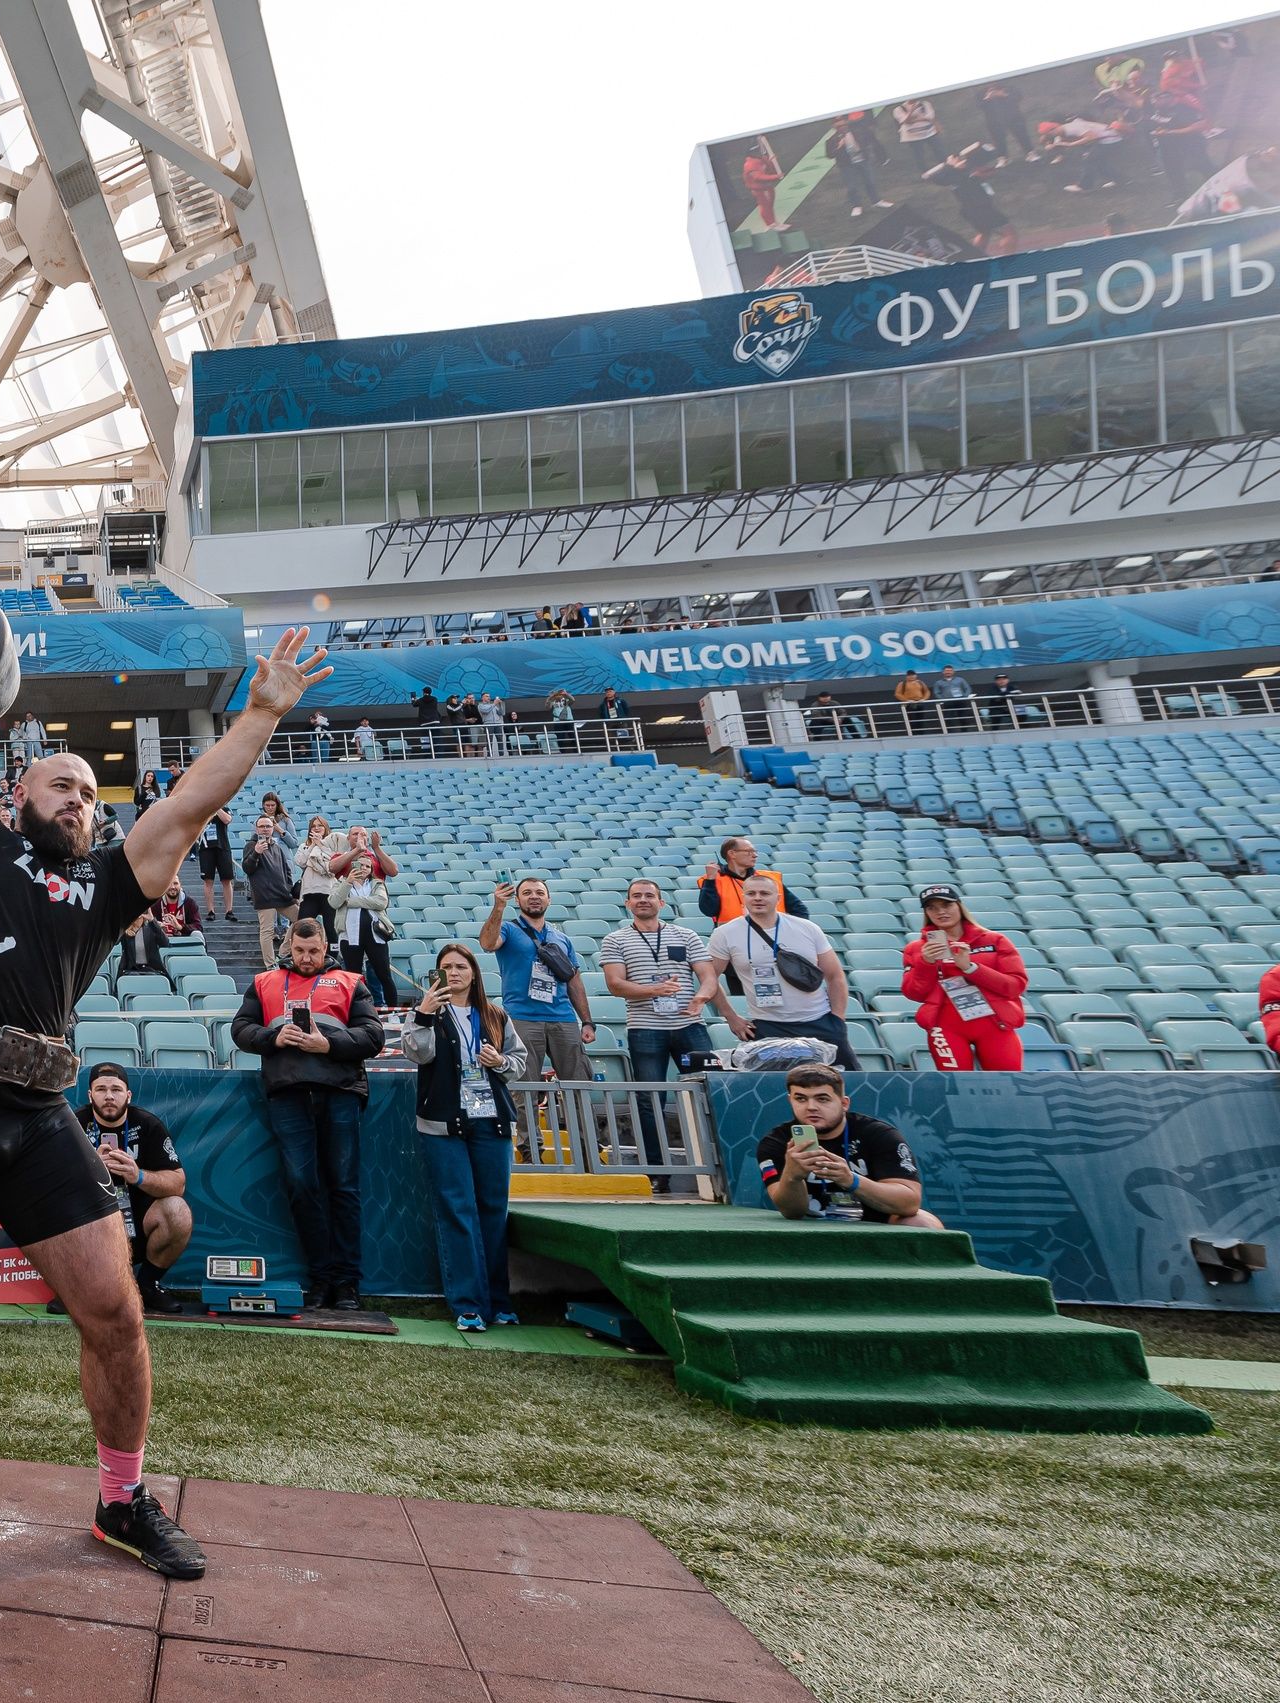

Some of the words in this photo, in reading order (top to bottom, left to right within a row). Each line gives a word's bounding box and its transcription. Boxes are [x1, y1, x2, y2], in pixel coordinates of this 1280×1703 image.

[622, 638, 810, 674] WELCOME
[814, 634, 872, 661] TO
[882, 623, 1020, 657] SOCHI!
[3, 1258, 16, 1268] БК
[3, 1273, 10, 1282] К
